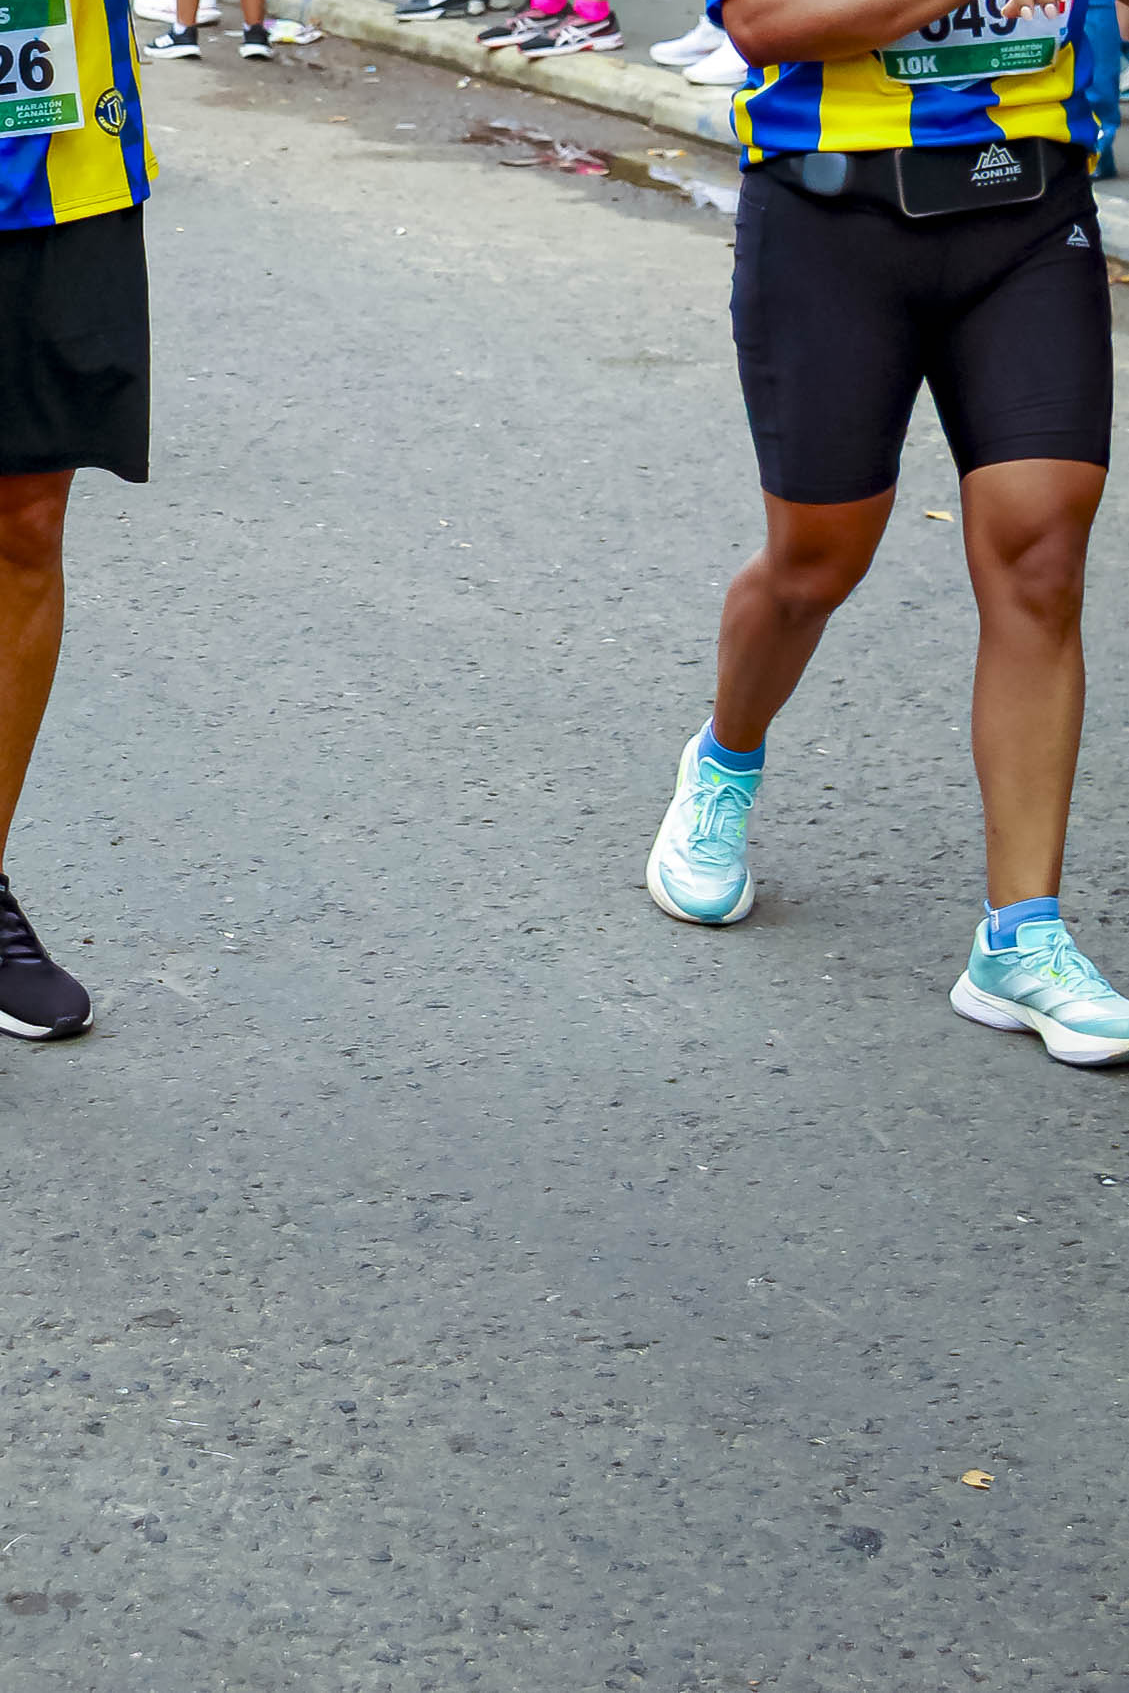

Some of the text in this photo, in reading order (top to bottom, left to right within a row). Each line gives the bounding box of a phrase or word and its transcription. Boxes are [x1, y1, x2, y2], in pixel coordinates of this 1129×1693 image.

[896, 54, 939, 75] 10K
[15, 100, 63, 113] MARATÓN
[17, 107, 63, 119] CANALLA
[970, 164, 1022, 182] AONIJIE
